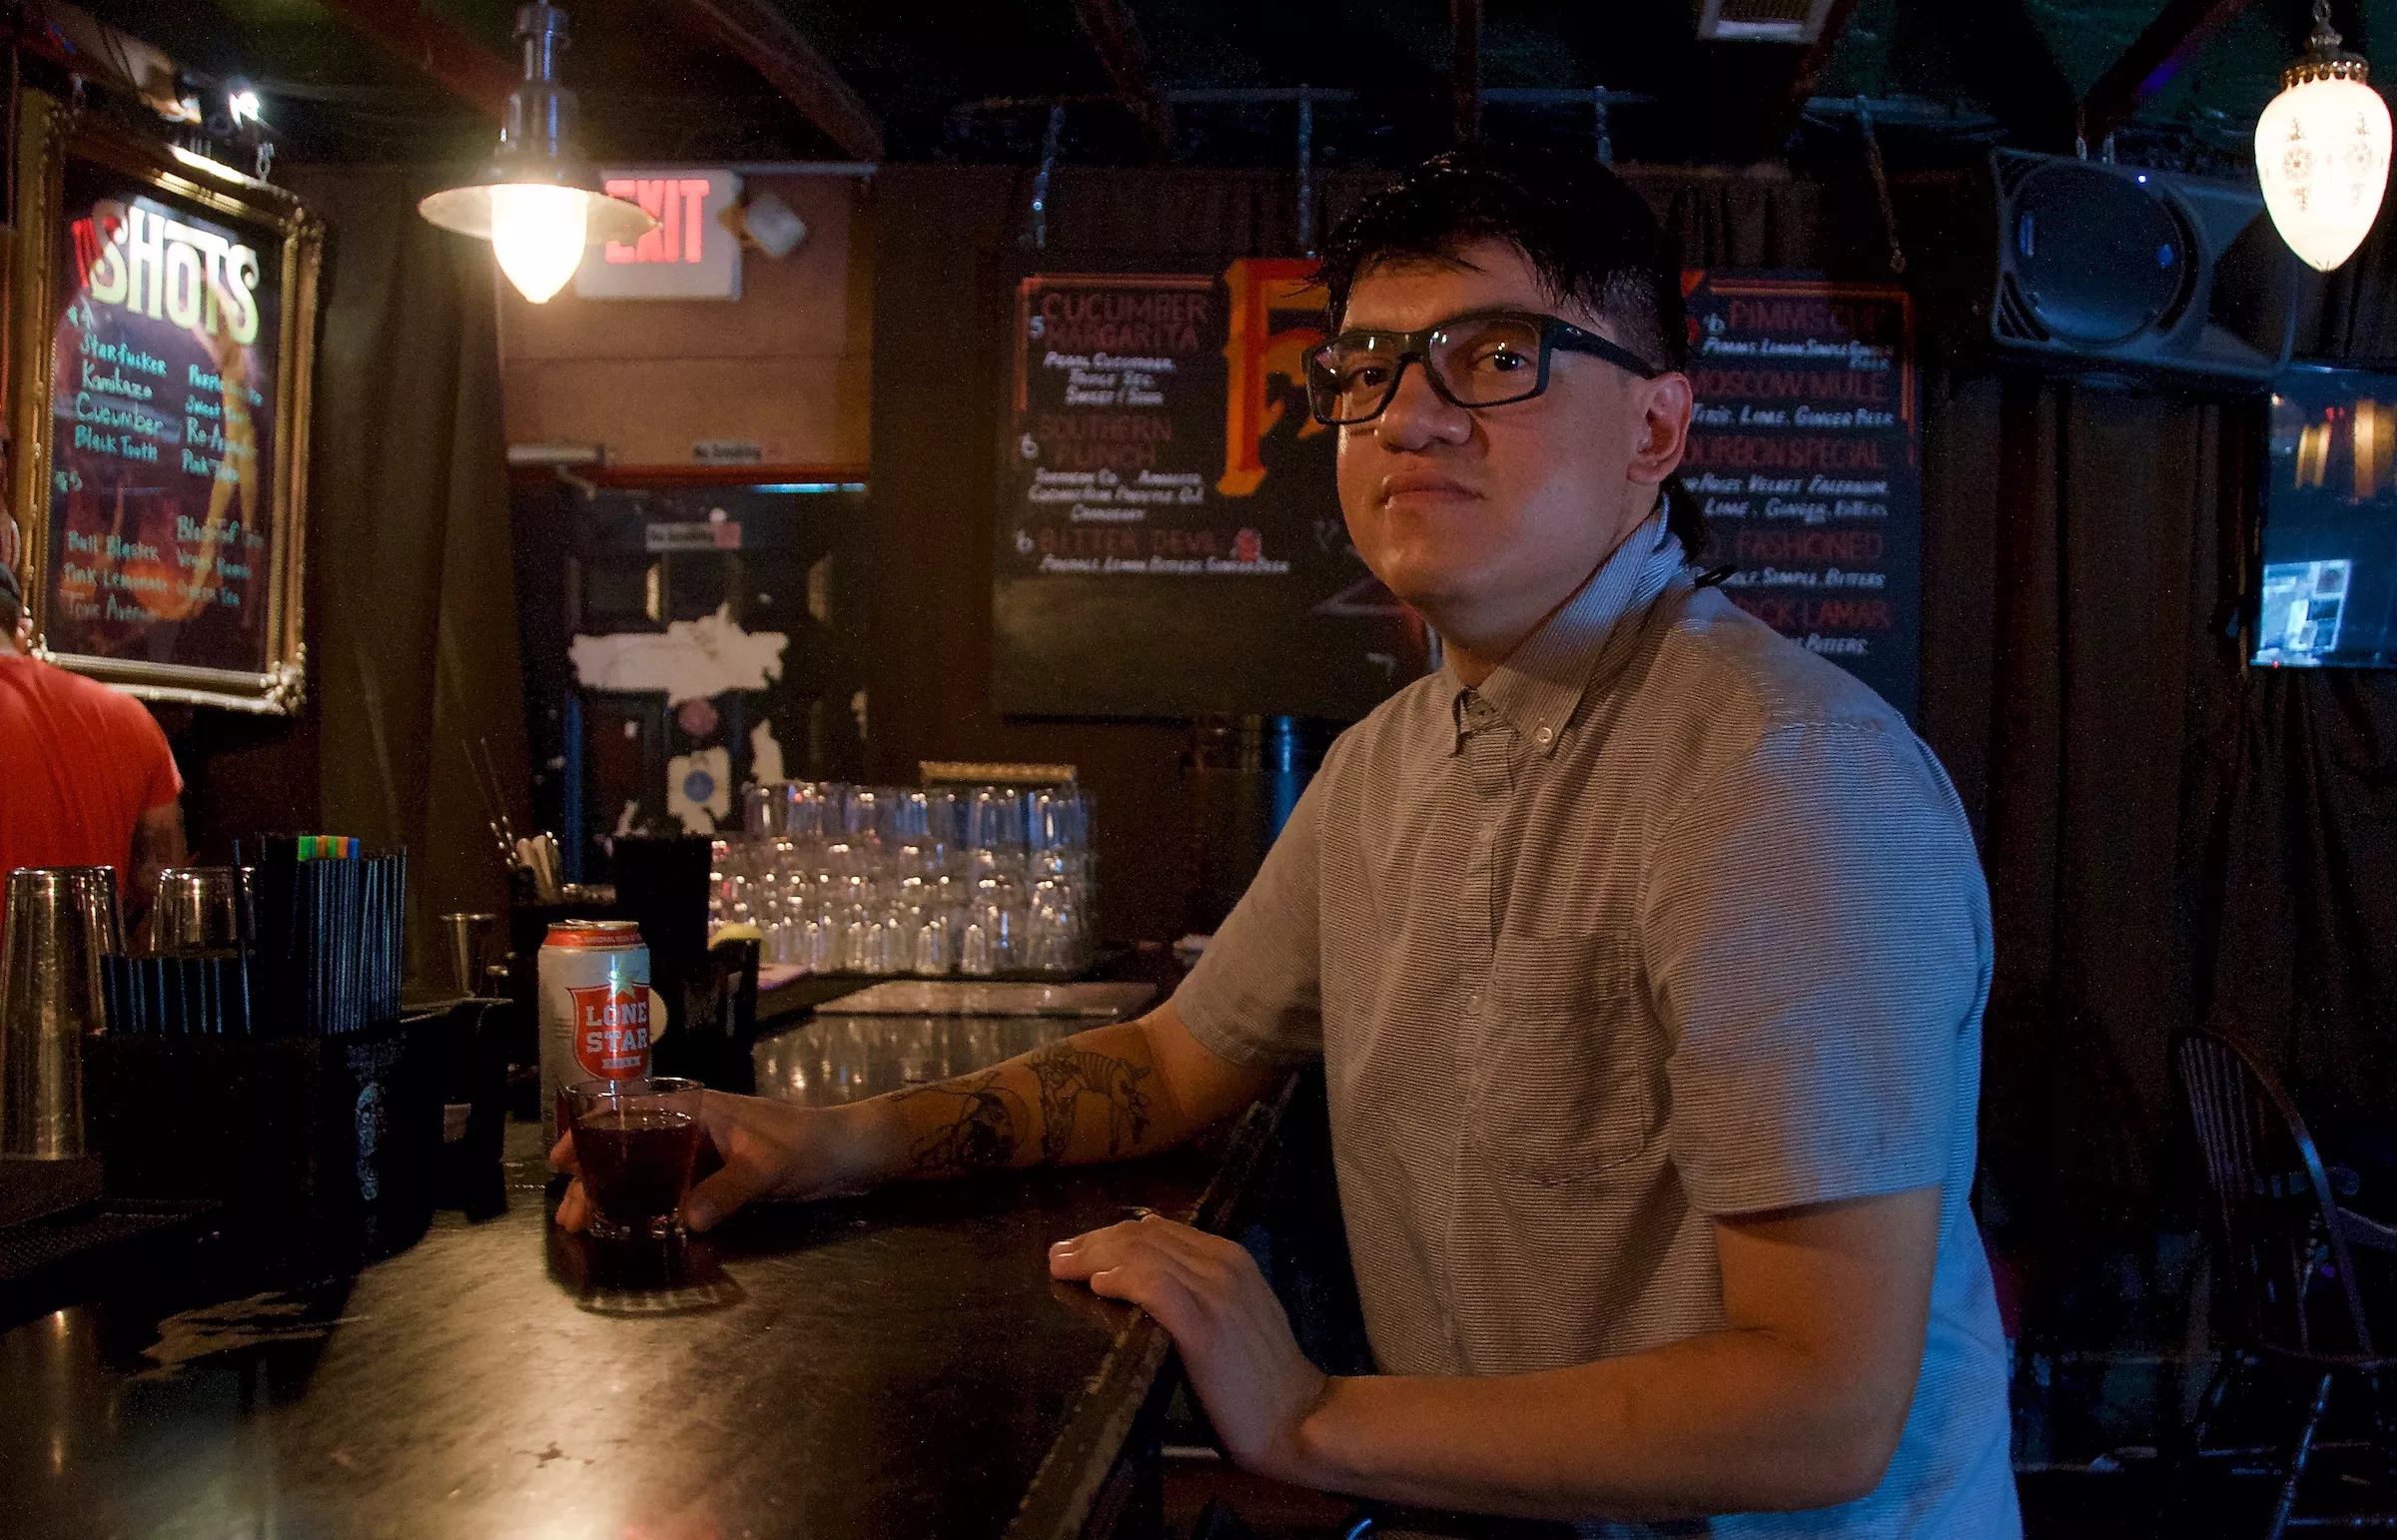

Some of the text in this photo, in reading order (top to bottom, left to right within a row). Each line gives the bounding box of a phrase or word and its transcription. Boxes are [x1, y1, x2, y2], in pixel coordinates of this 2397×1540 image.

[88, 199, 261, 346] SHOTS
[1042, 293, 1209, 325] CUCUMBER
[1045, 323, 1200, 352] MARGARITA
[1811, 371, 1889, 403] MULE
[76, 391, 165, 436] Cucumber
[1735, 529, 1885, 562] FASHIONED
[586, 1002, 648, 1027] LONE
[586, 1028, 648, 1054] STAR
